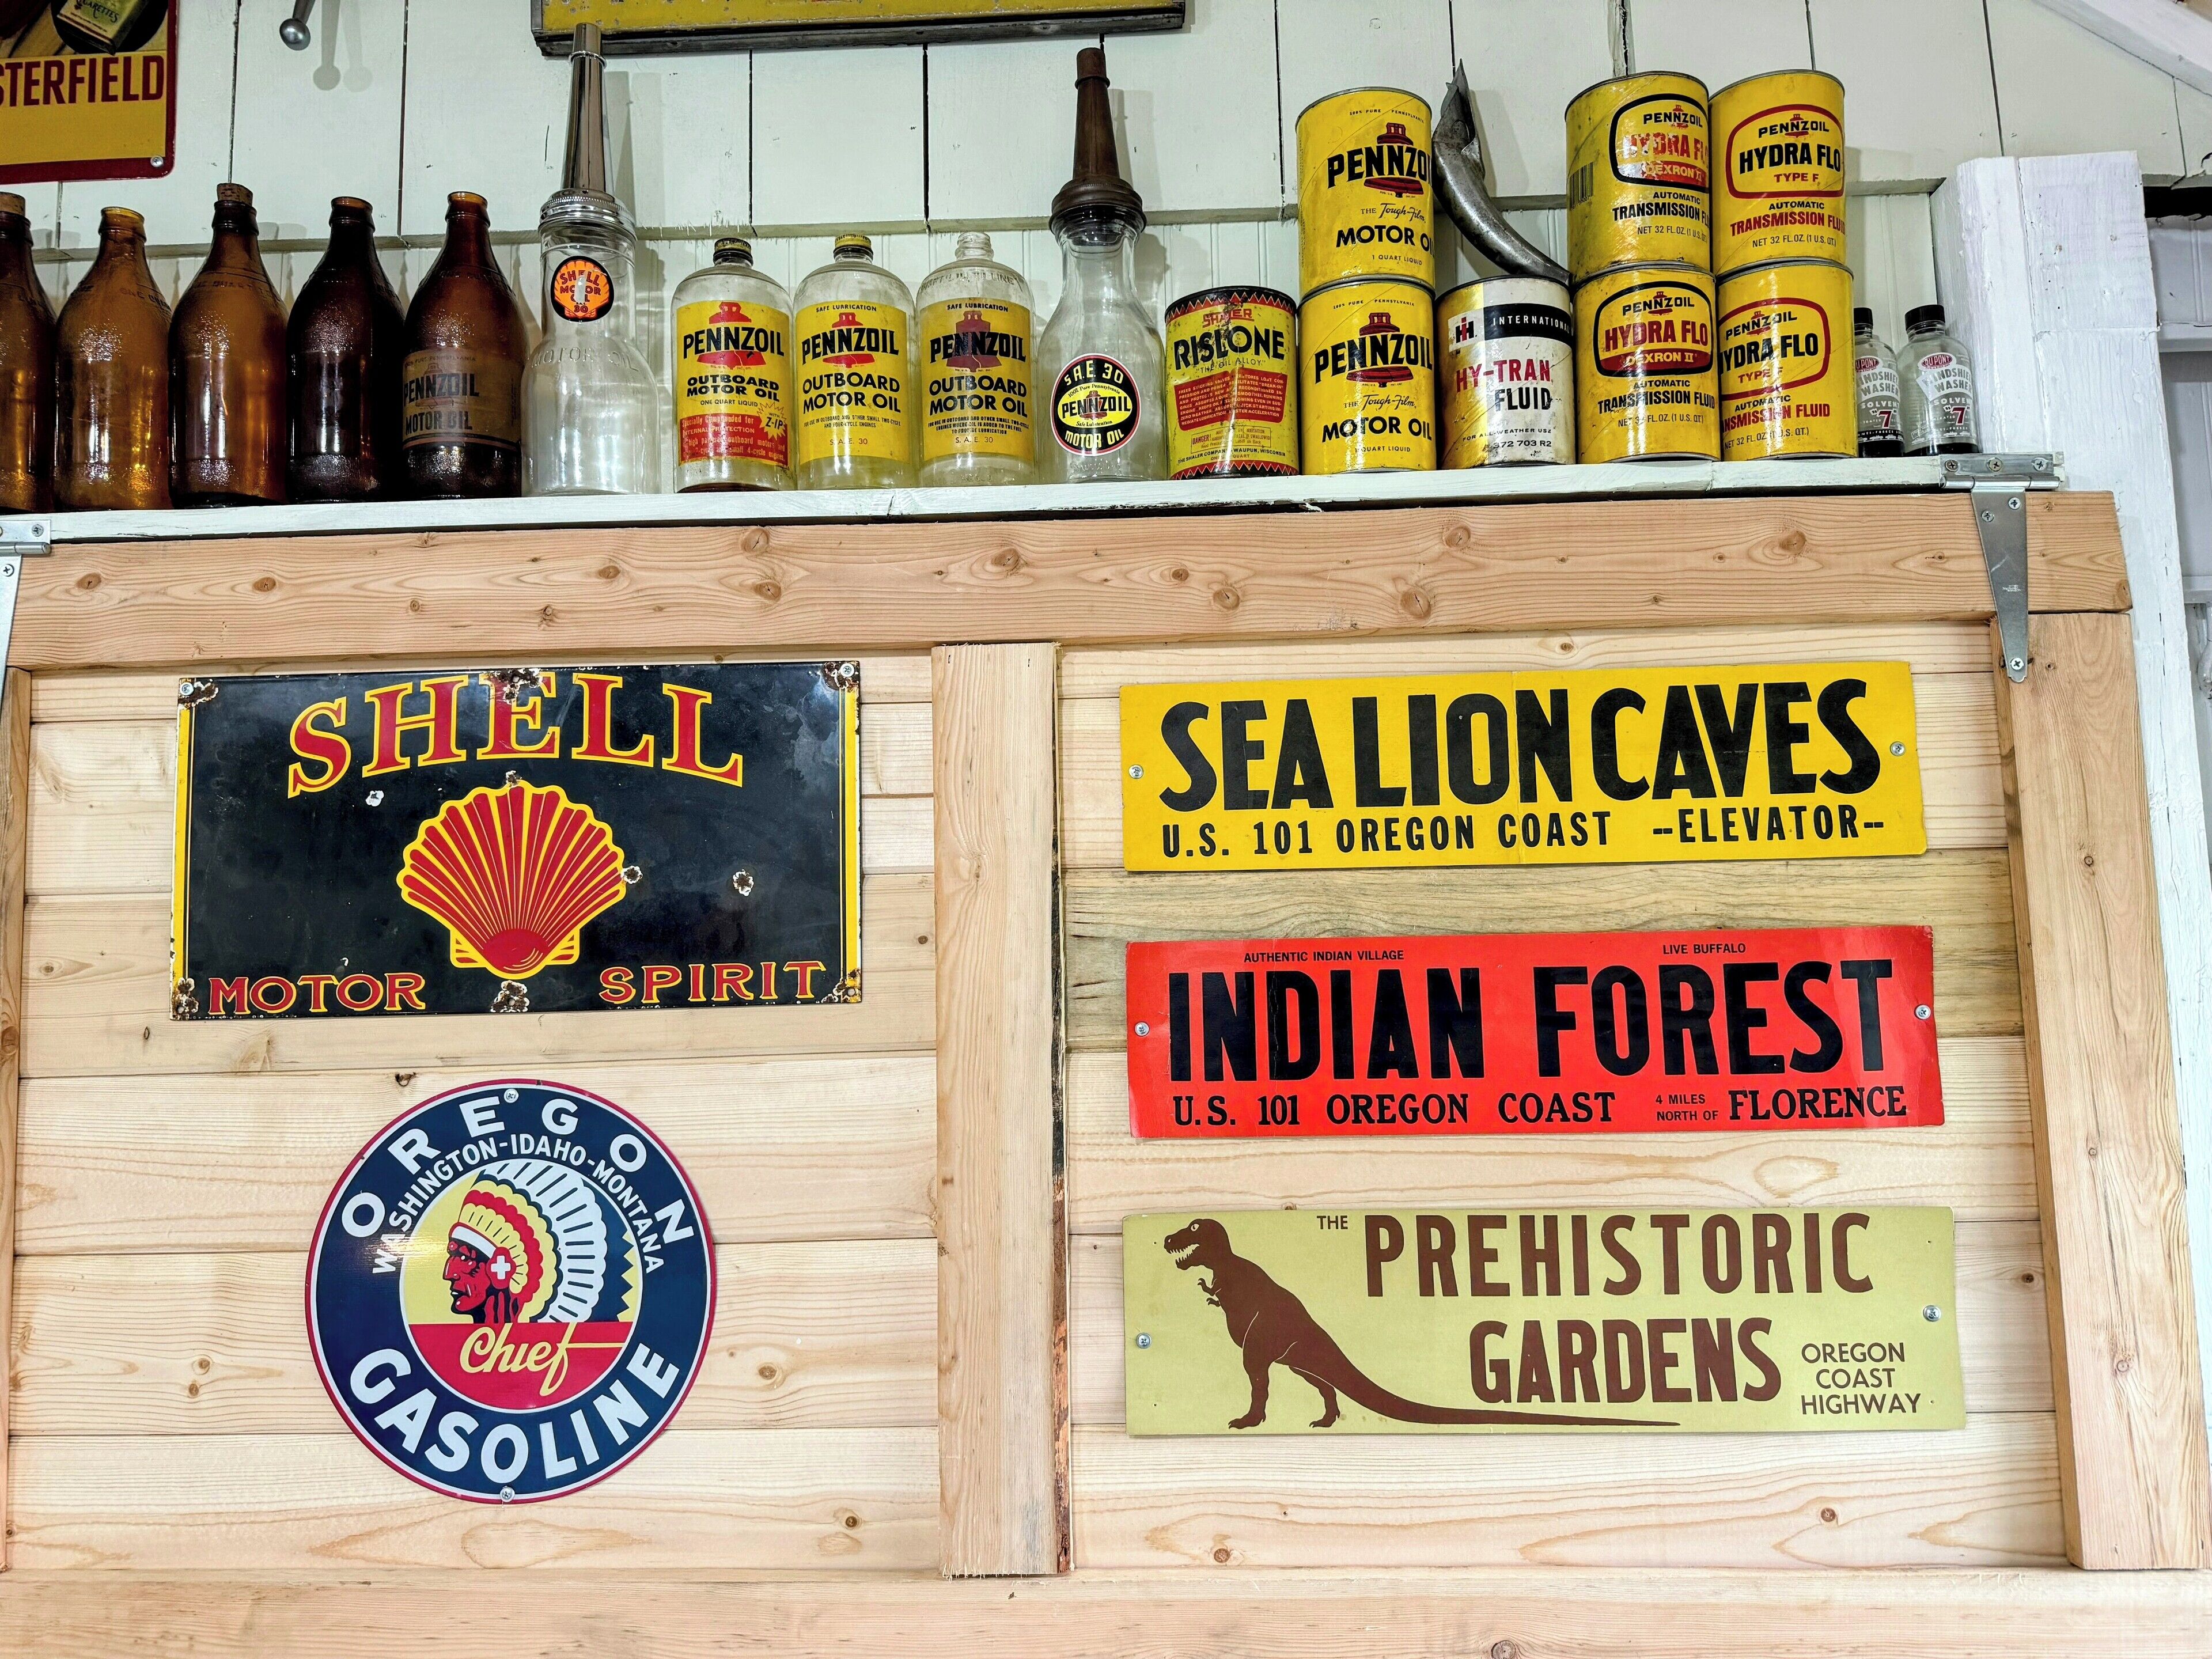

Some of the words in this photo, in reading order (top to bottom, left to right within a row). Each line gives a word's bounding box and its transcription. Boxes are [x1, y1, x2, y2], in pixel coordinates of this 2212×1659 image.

[1391, 109, 1424, 123] PENNSYLVANIA
[1643, 112, 1703, 127] PENNZOIL
[1758, 121, 1830, 138] PENNZOIL
[1739, 143, 1812, 174] HYDRA
[1817, 144, 1841, 173] FLO
[1646, 164, 1694, 179] DEXRON
[1774, 173, 1808, 183] TYPE
[1812, 173, 1819, 182] F
[1653, 192, 1700, 204] AUTOMATIC
[1768, 201, 1824, 210] AUTOMATIC
[1612, 202, 1700, 221] TRANSMISSION
[1638, 226, 1652, 234] NET
[1730, 211, 1824, 237] TRANSMISSION
[1336, 225, 1415, 248] MOTOR
[1752, 238, 1768, 248] NET
[1770, 236, 1779, 244] 32
[1814, 235, 1825, 244] U.S.
[1404, 256, 1422, 265] LIQUID
[560, 285, 601, 296] MOOR
[574, 305, 589, 313] 30
[965, 303, 1009, 312] LUBRICATION
[1622, 297, 1695, 316] PENNZOIL
[1493, 315, 1570, 334] INTERNATIONAL
[1726, 311, 1797, 340] PENNZOIL
[683, 327, 785, 359] PENNZOIL
[802, 328, 899, 365] PENNZOIL
[930, 331, 1027, 363] PENNZOIL
[1605, 320, 1676, 353] HYDRA
[1681, 320, 1709, 346] FLO
[1781, 333, 1819, 358] FLO
[1173, 325, 1285, 370] RISLONE
[1218, 361, 1231, 369] OIL
[1315, 334, 1433, 384] PENNZOIL
[1626, 352, 1681, 368] DEXRON
[688, 374, 779, 391] OUTBOARD
[802, 372, 900, 394] OUTBOARD
[1102, 362, 1124, 384] 30
[1456, 359, 1551, 393] HY-TRAN
[1738, 368, 1770, 384] TYPE
[404, 373, 480, 407] PENNZOIL
[687, 385, 747, 397] MOTOR
[755, 388, 780, 402] OIL
[929, 375, 1027, 397] OUTBOARD
[1633, 380, 1690, 389] AUTOMATIC
[1861, 382, 1899, 397] WASHER
[804, 392, 866, 414] MOTOR
[872, 393, 901, 413] OIL
[930, 394, 997, 416] MOTOR
[1002, 397, 1028, 418] OIL
[1062, 396, 1131, 419] PENNZOIL
[1495, 387, 1551, 411] FLUID
[1597, 390, 1691, 414] TRANSMISSION
[1694, 392, 1715, 410] FLUID
[1734, 395, 1791, 412] AUTOMATIC
[745, 416, 754, 425] for
[1796, 404, 1830, 418] FLUID
[406, 411, 442, 435] MOTOR
[447, 411, 472, 430] OIL
[1322, 416, 1402, 443] MOTOR
[1408, 418, 1432, 441] OIL
[1479, 428, 1535, 438] ALL-WEATHER
[728, 437, 753, 445] outboard
[1065, 430, 1102, 449] MOTOR
[1107, 429, 1124, 445] OIL
[1493, 441, 1514, 449] 372
[1724, 438, 1734, 449] NET
[1737, 437, 1744, 446] 32
[1185, 453, 1203, 461] SHALER
[1260, 449, 1286, 457] WISCONSIN
[288, 672, 743, 799] SHELL
[1159, 699, 1334, 812] SEA
[1353, 689, 1573, 808] LION
[1591, 678, 1881, 801] CAVES
[1162, 822, 1229, 858] U.S.
[1254, 820, 1313, 855] 101
[1336, 815, 1475, 853] OREGON
[1498, 810, 1611, 848] COAST
[1244, 951, 1309, 963] AUTHENTIC
[1313, 950, 1352, 961] INDIAN
[1357, 949, 1404, 961] VILLAGE
[1662, 944, 1689, 955] LIVE
[1693, 942, 1746, 954] BUFFALO
[207, 972, 426, 1014] MOTOR
[599, 961, 827, 1004] SPIRIT
[1169, 967, 1485, 1082] INDIAN
[1533, 959, 1893, 1078] FOREST
[1173, 1095, 1236, 1127] U.S.
[1257, 1094, 1300, 1126] 101
[1327, 1093, 1468, 1125] OREGON
[1498, 1091, 1616, 1123] COAST
[1655, 1094, 1663, 1105] 4
[1668, 1094, 1706, 1105] MILES
[1656, 1111, 1699, 1122] NORTH
[1703, 1109, 1719, 1121] OF
[1729, 1085, 1907, 1120] FLORENCE
[342, 1097, 694, 1248] OREGON
[1317, 1215, 1349, 1230] THE
[1364, 1212, 1874, 1297] PREHISTORIC
[460, 1323, 582, 1396] Chief
[1469, 1317, 1782, 1404] GARDENS
[1801, 1342, 1905, 1363] OREGON
[1816, 1368, 1895, 1389] COAST
[350, 1343, 679, 1483] GASOLINE
[1801, 1393, 1921, 1415] HIGHWAY
